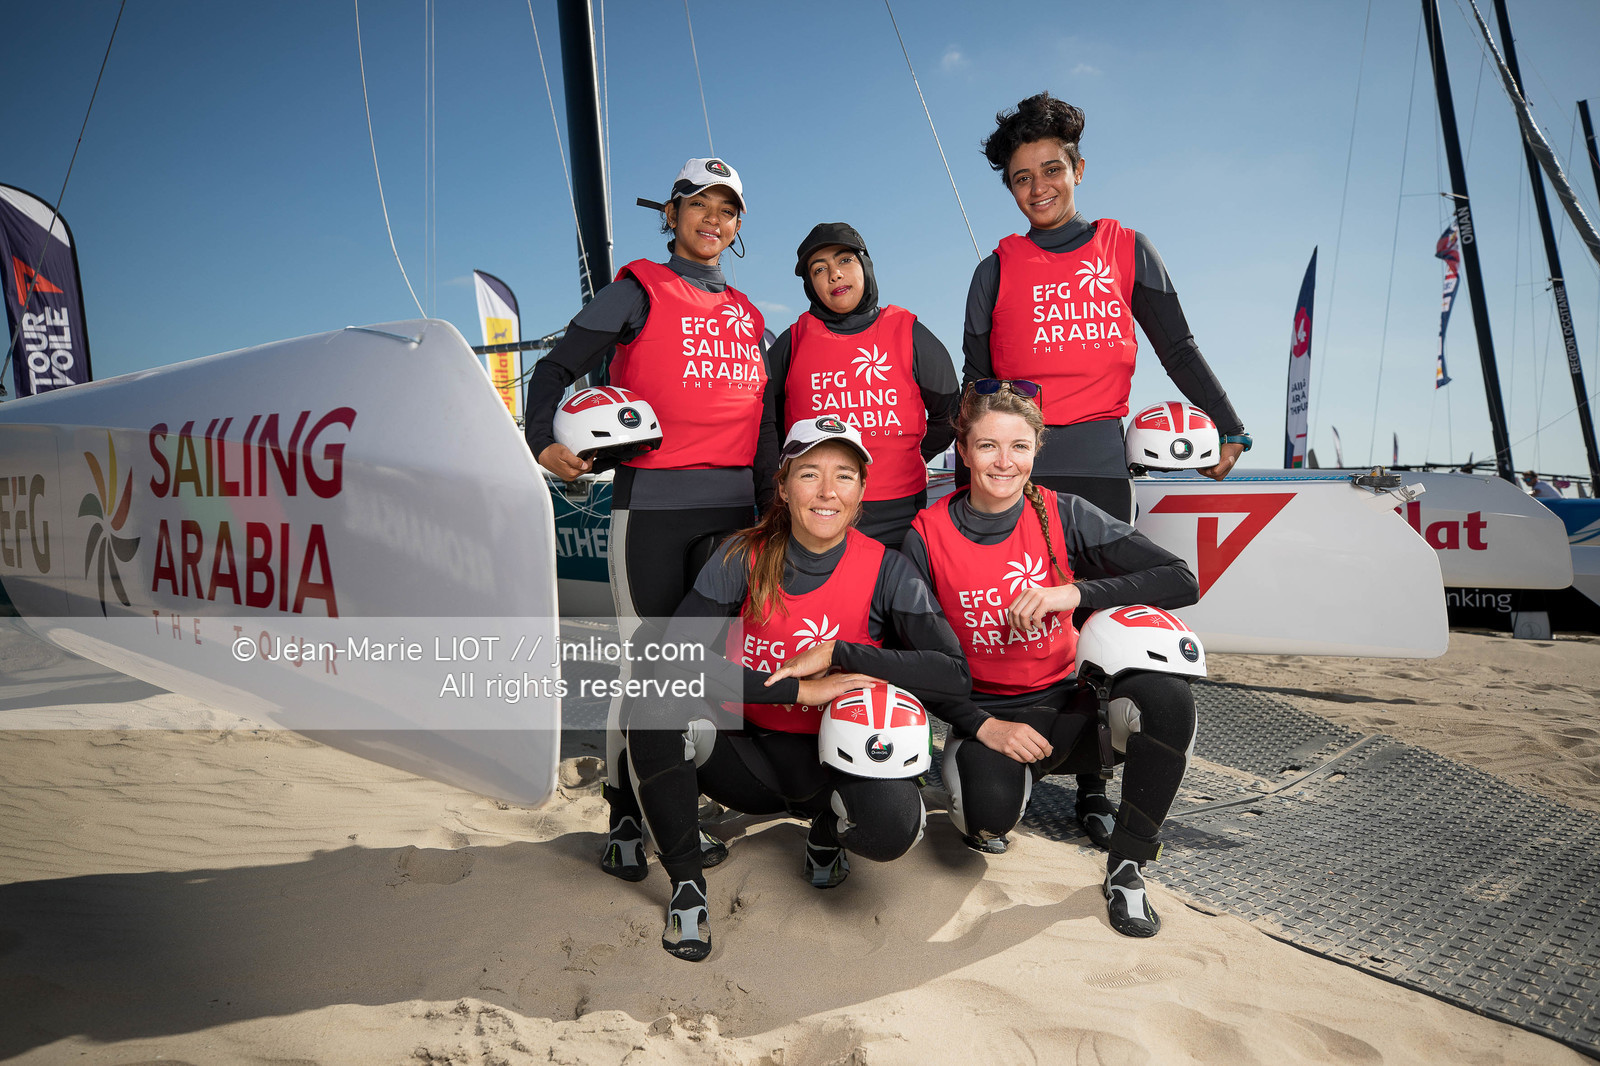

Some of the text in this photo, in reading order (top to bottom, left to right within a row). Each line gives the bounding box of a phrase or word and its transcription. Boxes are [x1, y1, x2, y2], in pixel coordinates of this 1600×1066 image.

[1457, 206, 1474, 245] OMAN
[1032, 281, 1071, 303] EFG
[1033, 300, 1121, 323] SAILING
[681, 316, 720, 336] EFG
[1033, 321, 1122, 344] ARABIA
[1555, 286, 1582, 375] REGION OCCITANIE
[22, 312, 53, 395] TOUR
[44, 306, 76, 386] VOILE
[682, 338, 761, 362] SAILING
[1033, 344, 1064, 354] THE
[682, 360, 760, 382] ARABIA
[811, 370, 847, 391] EFG
[682, 381, 760, 392] THE TOUR
[811, 388, 898, 411] SAILING
[816, 410, 902, 429] ABIA
[149, 406, 358, 499] SAILING
[0, 473, 51, 575] EFG
[151, 518, 340, 619] ARABIA
[959, 587, 1002, 609] EFG
[152, 609, 202, 646] THE
[971, 615, 1061, 646] ARABIA
[743, 633, 786, 660] EFG
[973, 628, 1063, 655] THE TOUR
